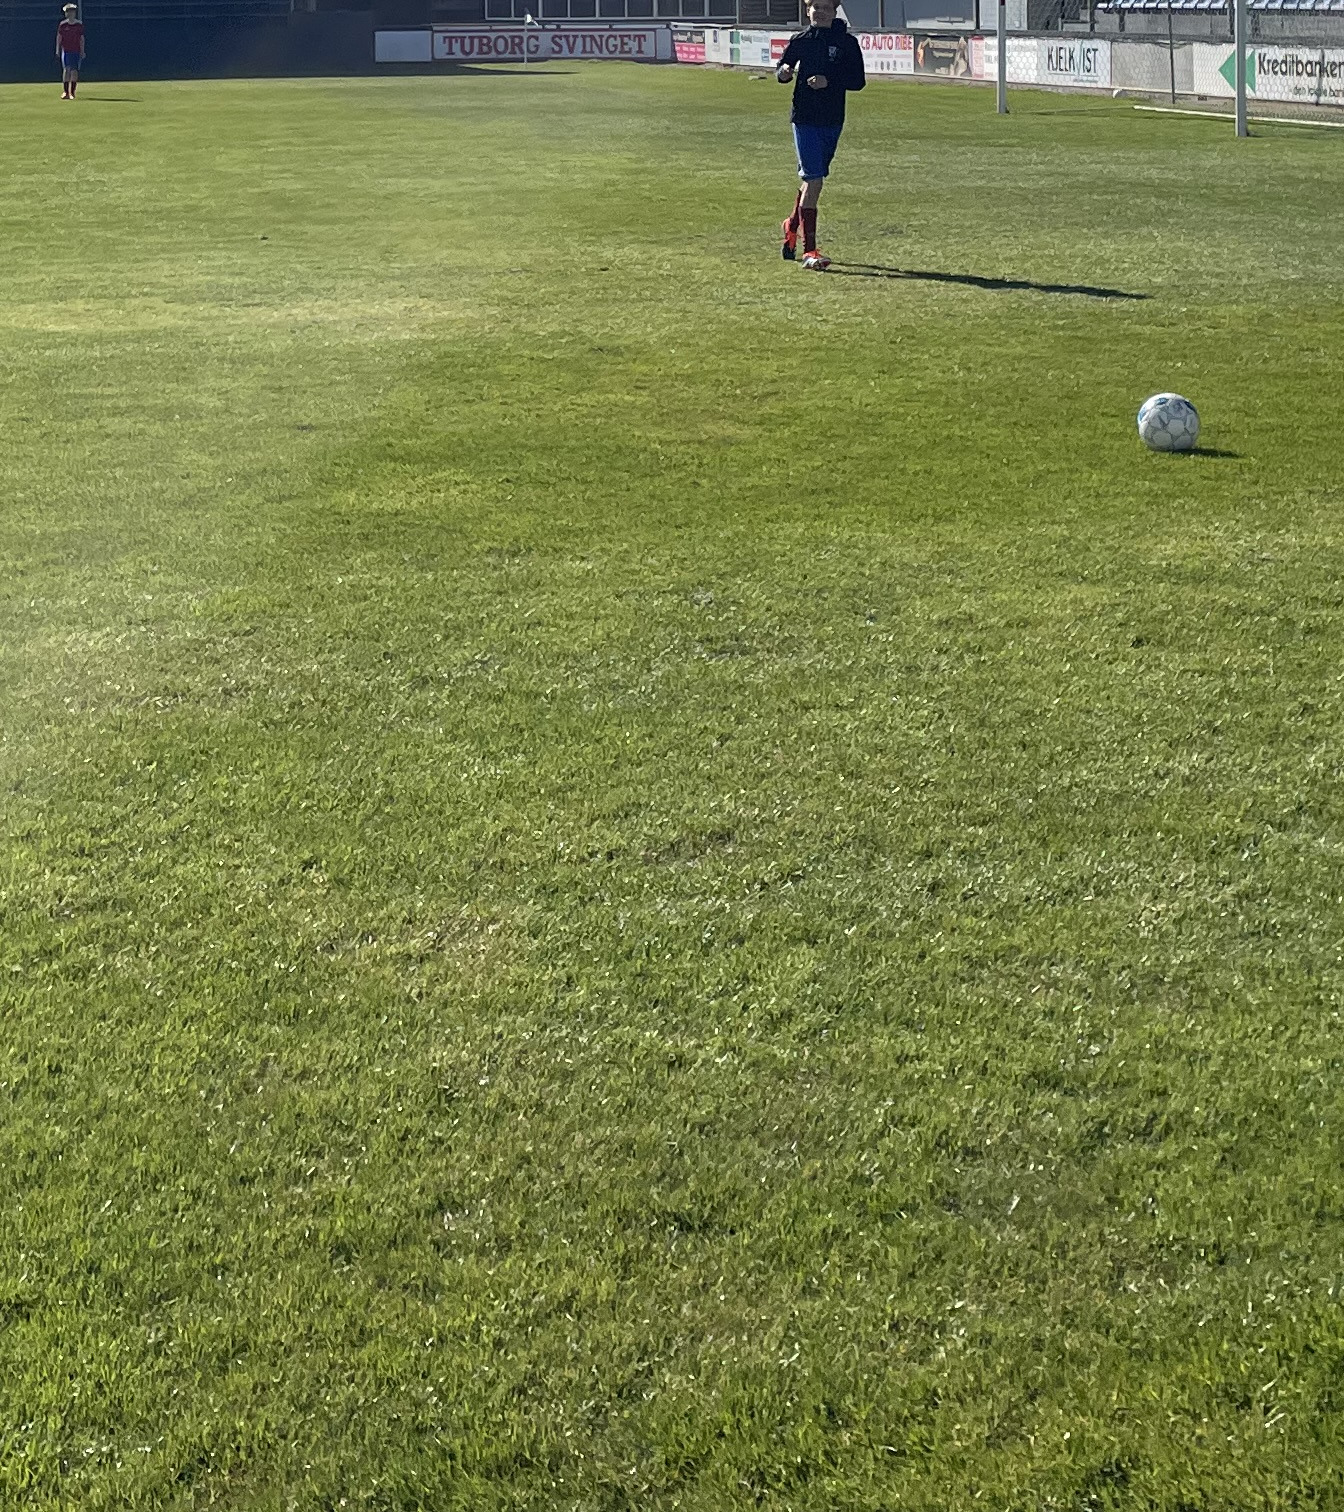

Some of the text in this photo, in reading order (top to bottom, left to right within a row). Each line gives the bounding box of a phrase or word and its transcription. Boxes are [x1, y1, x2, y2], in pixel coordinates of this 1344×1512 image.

[442, 34, 540, 57] TUBORG
[551, 34, 647, 56] SVINGET
[872, 35, 894, 50] AUTO
